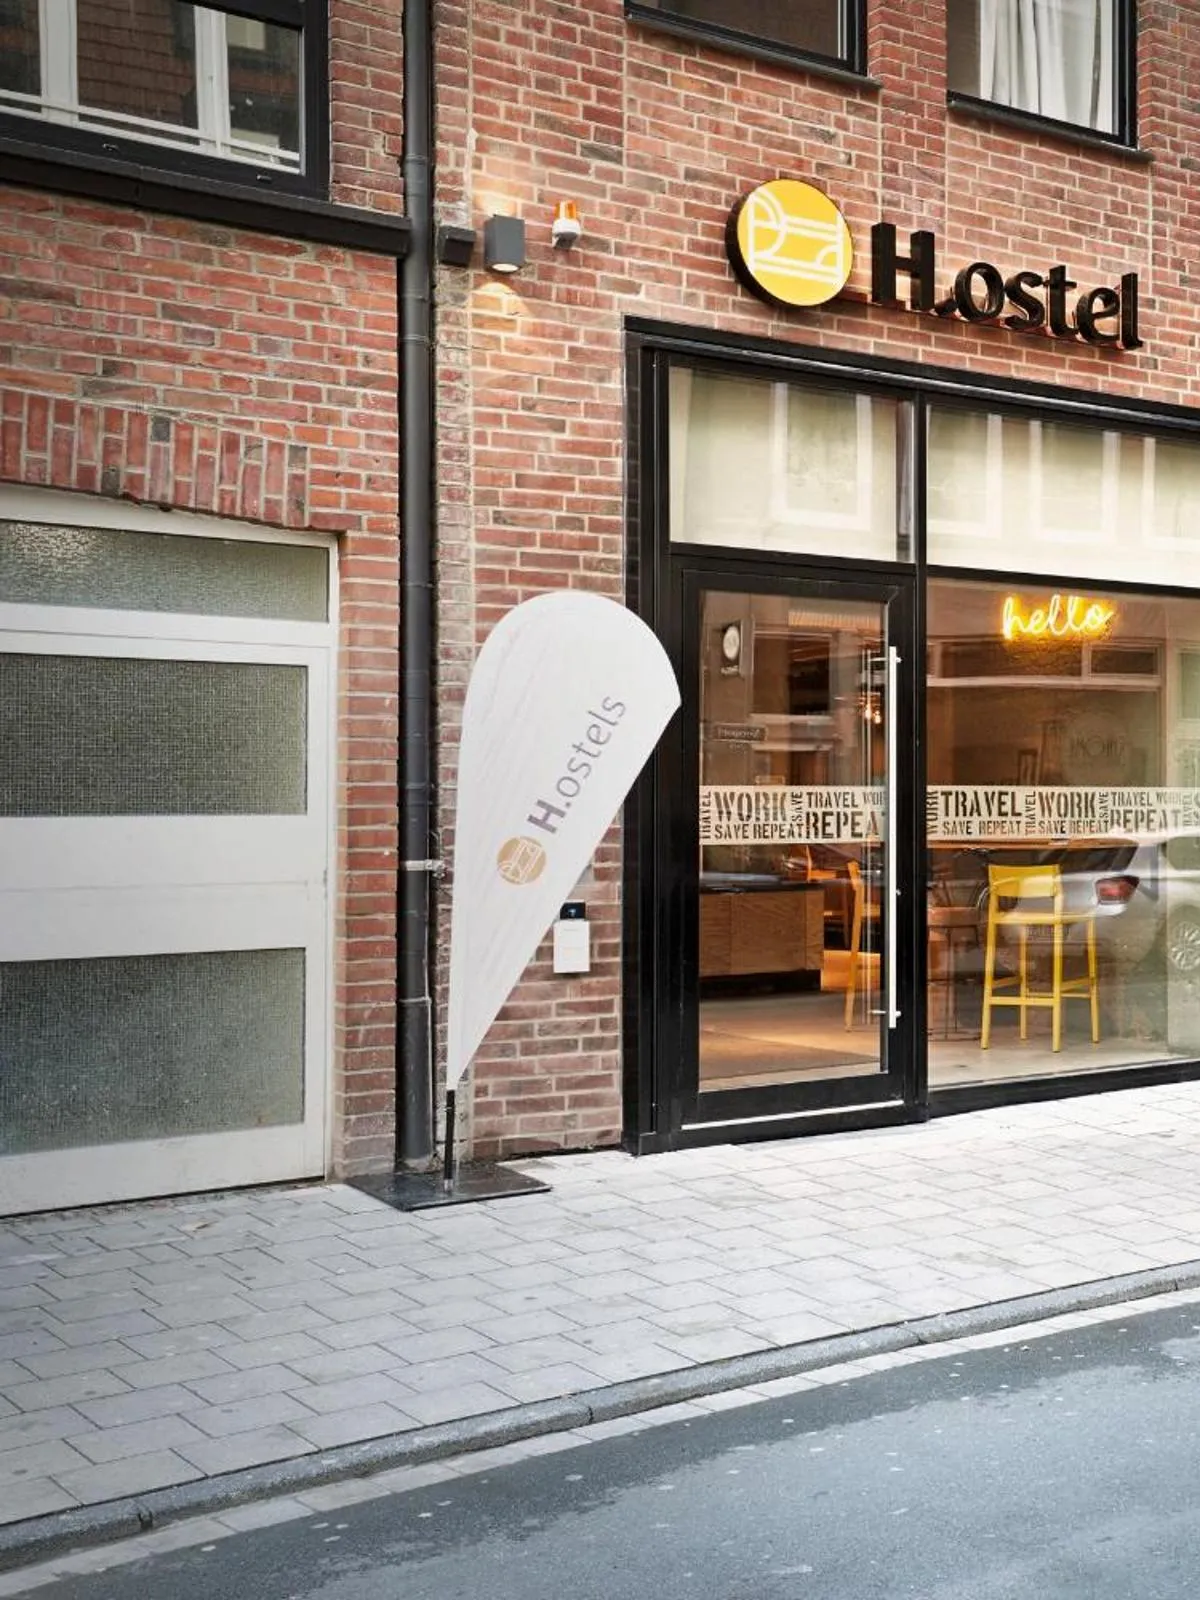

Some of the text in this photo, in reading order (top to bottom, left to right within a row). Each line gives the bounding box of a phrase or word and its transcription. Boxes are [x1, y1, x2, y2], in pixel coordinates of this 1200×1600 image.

[870, 222, 1143, 350] H.ostel
[1002, 594, 1114, 640] hello
[527, 695, 627, 834] H.ostels
[714, 791, 787, 822] WORK
[791, 791, 803, 823] SAVE
[806, 791, 858, 808] TRAVEL
[941, 791, 1022, 818] TRAVEL
[1025, 791, 1036, 835] TRAVEL
[1038, 791, 1097, 819] WORK
[1098, 791, 1108, 819] SAVE
[1111, 791, 1152, 807] TRAVEL
[714, 823, 805, 839] SAVE REPEAT
[805, 811, 886, 839] REPEA
[943, 820, 1021, 835] SAVE REPEAT
[1038, 820, 1110, 834] SAVE REPEAT
[1110, 809, 1181, 833] REPEAT
